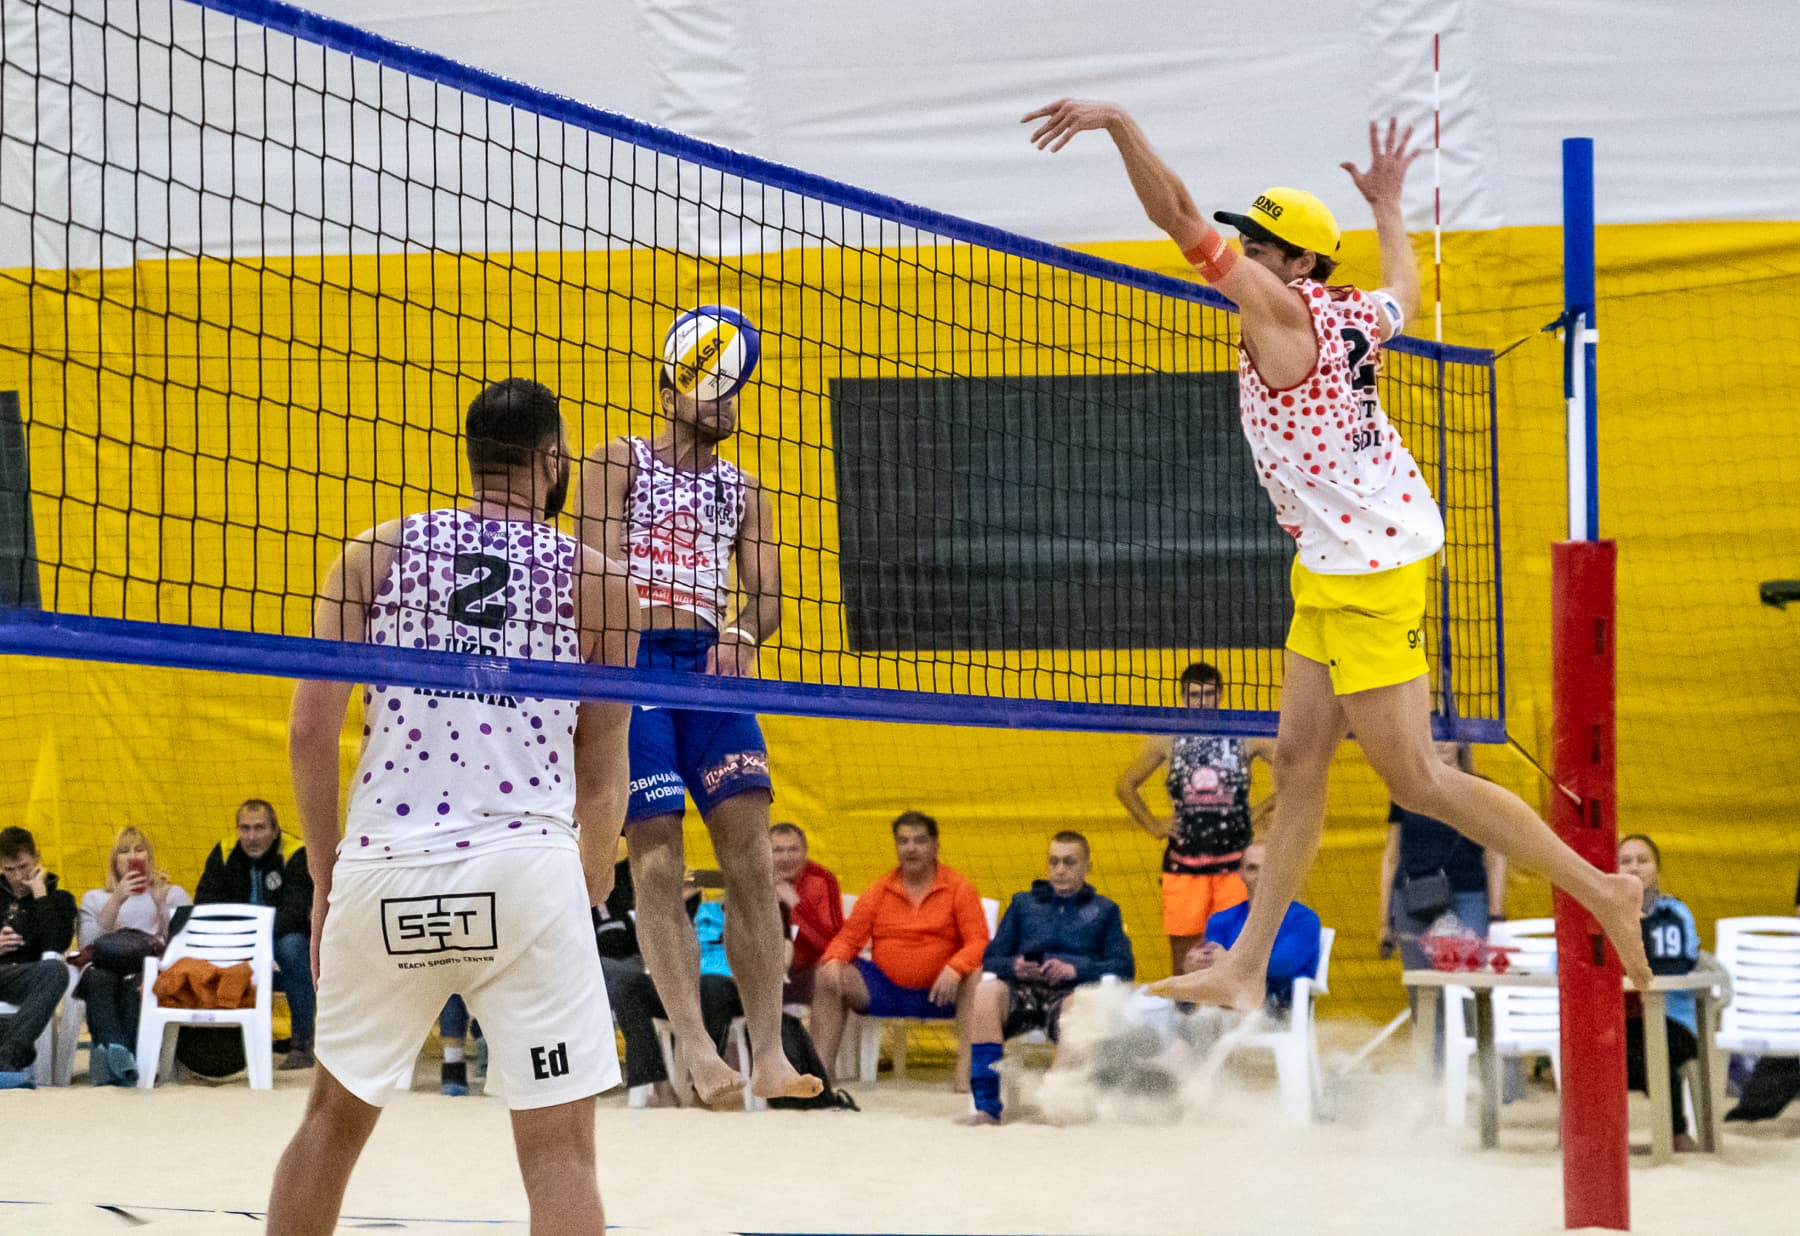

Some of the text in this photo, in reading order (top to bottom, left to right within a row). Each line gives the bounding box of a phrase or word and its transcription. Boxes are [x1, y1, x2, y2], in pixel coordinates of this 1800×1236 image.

[1253, 195, 1284, 218] ONG
[1340, 327, 1377, 390] 2
[446, 552, 511, 630] 2
[398, 911, 477, 939] SET
[1651, 926, 1682, 958] 19
[398, 962, 426, 970] BEACH
[427, 957, 461, 968] SPORTS
[530, 1042, 570, 1081] Ed
